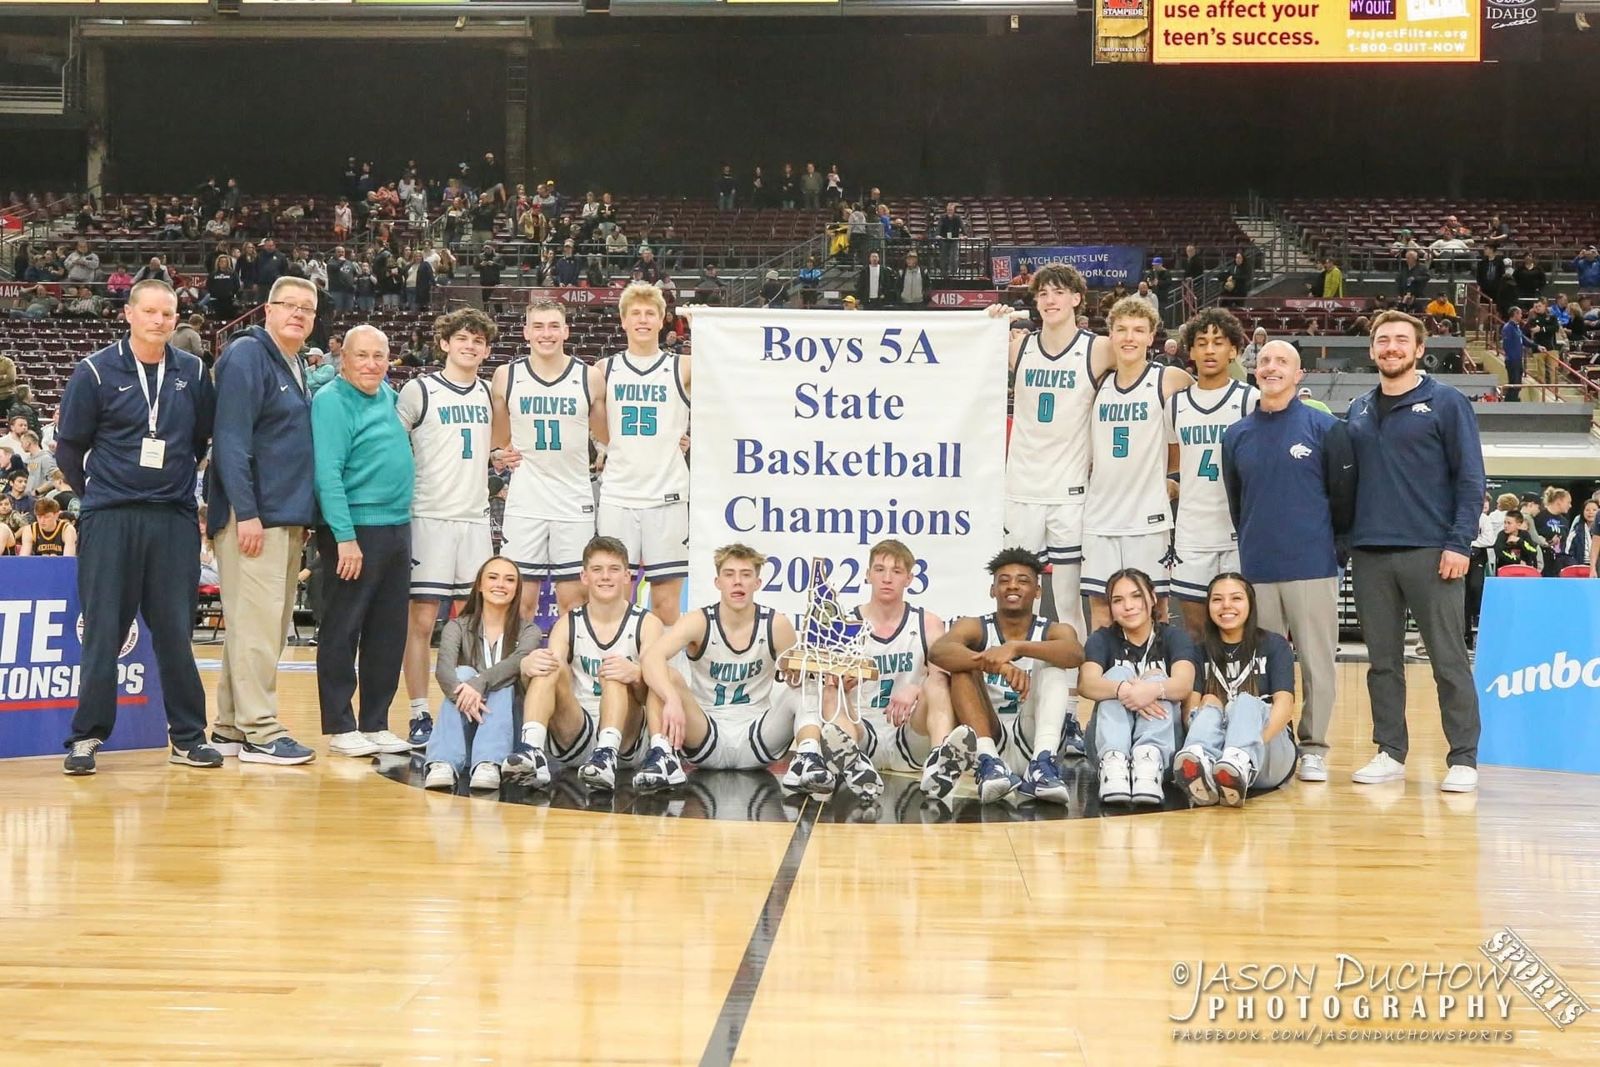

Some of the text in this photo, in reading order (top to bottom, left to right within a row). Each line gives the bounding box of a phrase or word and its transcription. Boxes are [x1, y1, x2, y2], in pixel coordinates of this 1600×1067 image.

[1103, 8, 1144, 16] STAMPEDE
[1164, 0, 1319, 22] use affect your
[1164, 28, 1320, 45] teen's success.
[1347, 28, 1468, 40] ProjectFilter.org
[1348, 43, 1466, 53] 1-800-QUIT-NOW
[1019, 253, 1109, 265] WATCH EVENTS LIVE
[571, 291, 586, 302] A15
[940, 293, 956, 304] A16
[760, 326, 940, 373] Boys 5A
[1025, 368, 1076, 389] WOLVES
[614, 384, 667, 402] WOLVES
[794, 382, 904, 420] State
[438, 405, 489, 424] WOLVES
[519, 396, 577, 416] WOLVES
[1037, 392, 1055, 423] 0
[1099, 401, 1148, 422] WOLVES
[621, 406, 657, 436] 25
[460, 428, 473, 459] 1
[533, 419, 562, 450] 11
[1112, 426, 1130, 458] 5
[1180, 424, 1228, 445] WOLVE
[733, 438, 962, 478] Basketball
[1197, 449, 1219, 481] 4
[724, 496, 971, 545] Champions
[709, 658, 763, 682] WOLVES
